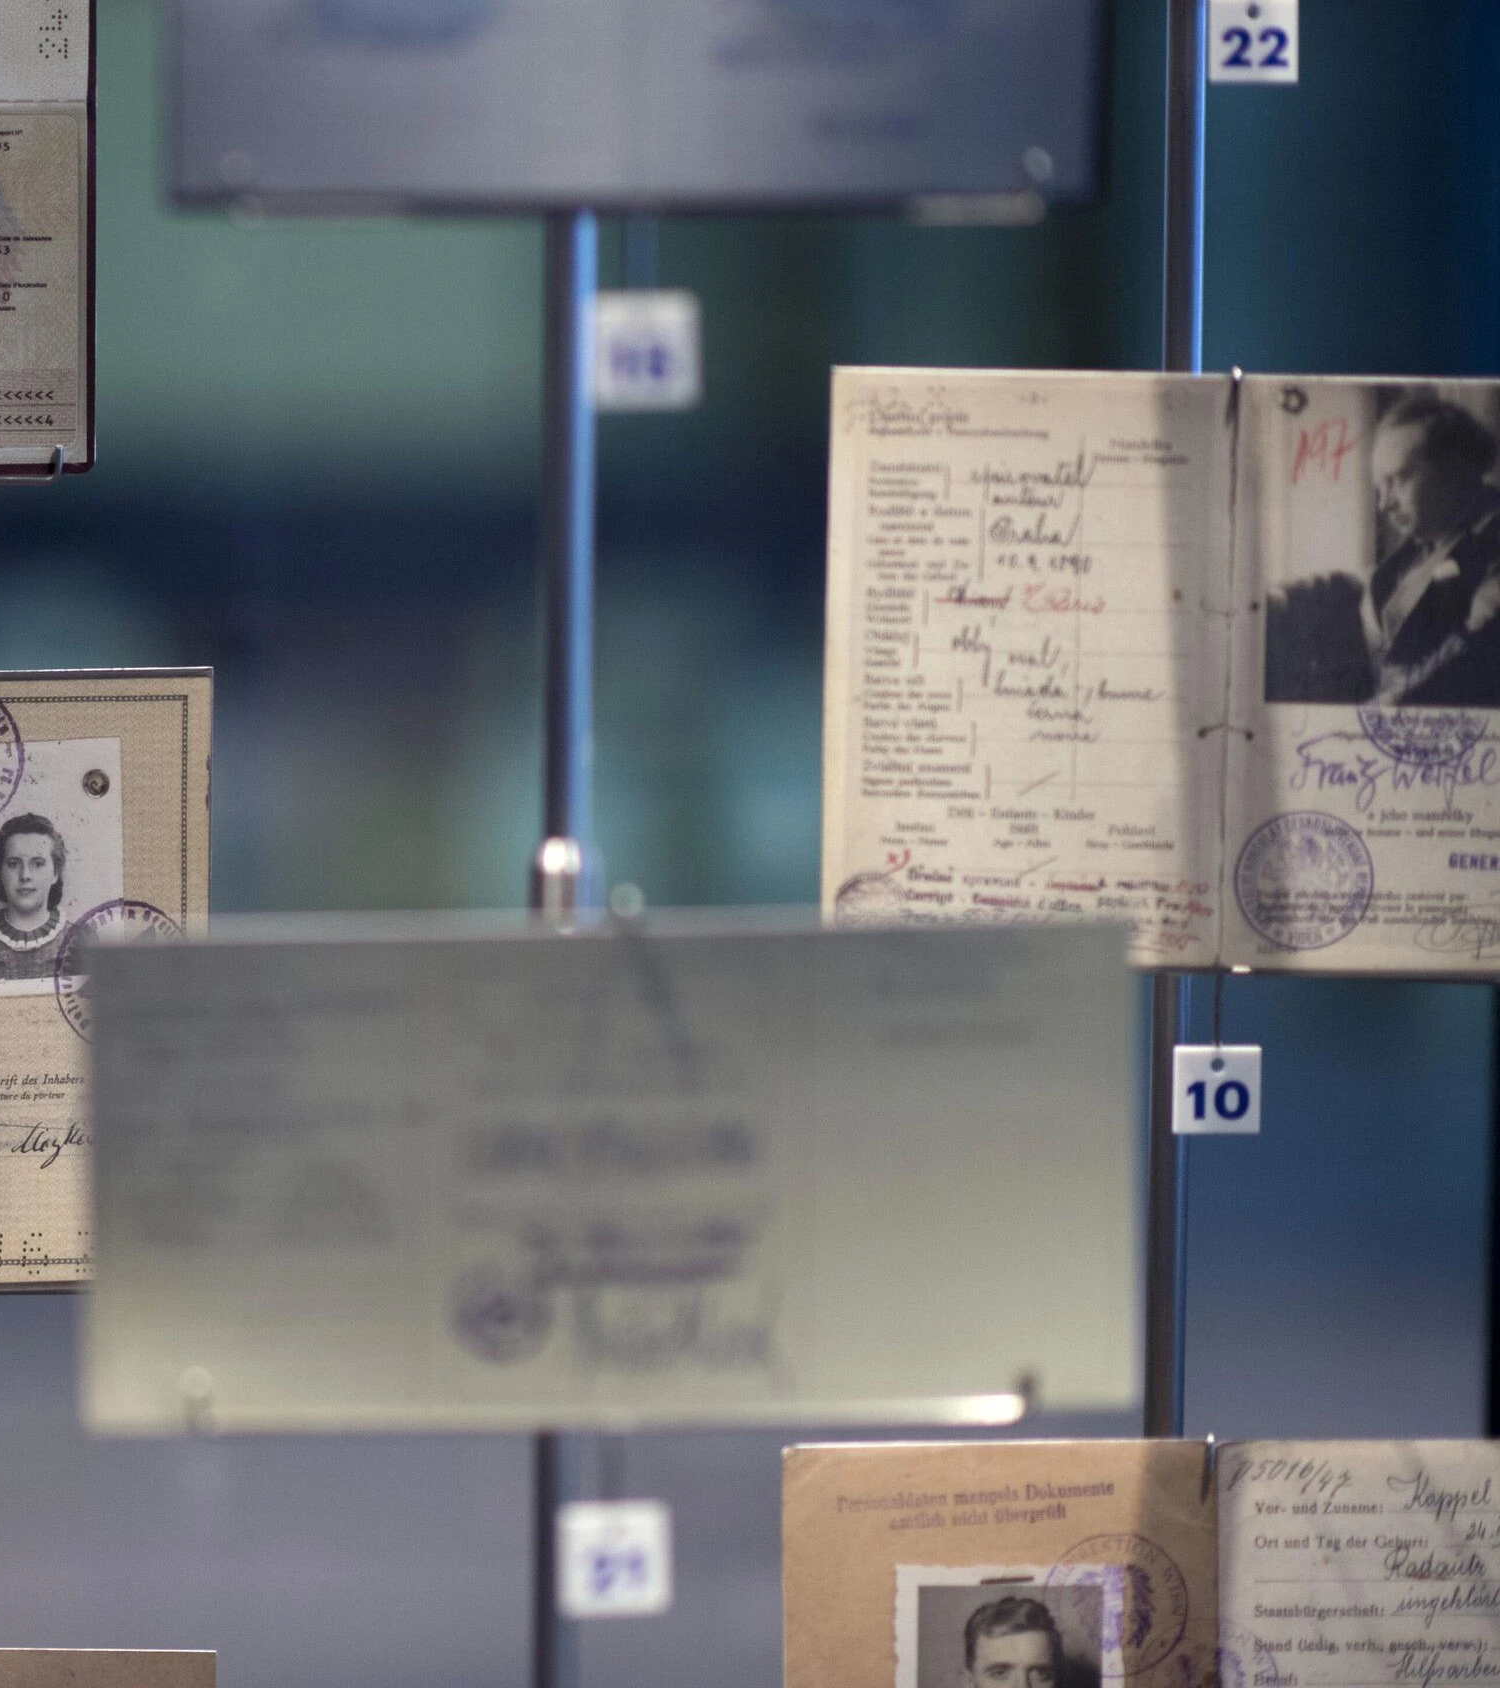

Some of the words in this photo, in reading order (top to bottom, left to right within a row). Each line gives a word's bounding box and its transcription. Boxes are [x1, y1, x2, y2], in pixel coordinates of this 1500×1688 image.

[1222, 27, 1289, 67] 22
[22, 1075, 38, 1085] des
[33, 1092, 65, 1102] porteur
[1187, 1080, 1250, 1121] 10
[1024, 1480, 1115, 1502] Dokumente
[1254, 1501, 1288, 1515] Vor-
[1292, 1501, 1317, 1514] und
[1321, 1501, 1384, 1515] Zuname:
[1254, 1535, 1279, 1549] Ort
[1284, 1535, 1310, 1548] und
[1315, 1535, 1341, 1552] Tag
[1345, 1535, 1368, 1549] der
[1374, 1535, 1429, 1550] Geburt:
[1253, 1604, 1385, 1621] Staatsbürgerschaft:
[1253, 1637, 1292, 1653] Stand
